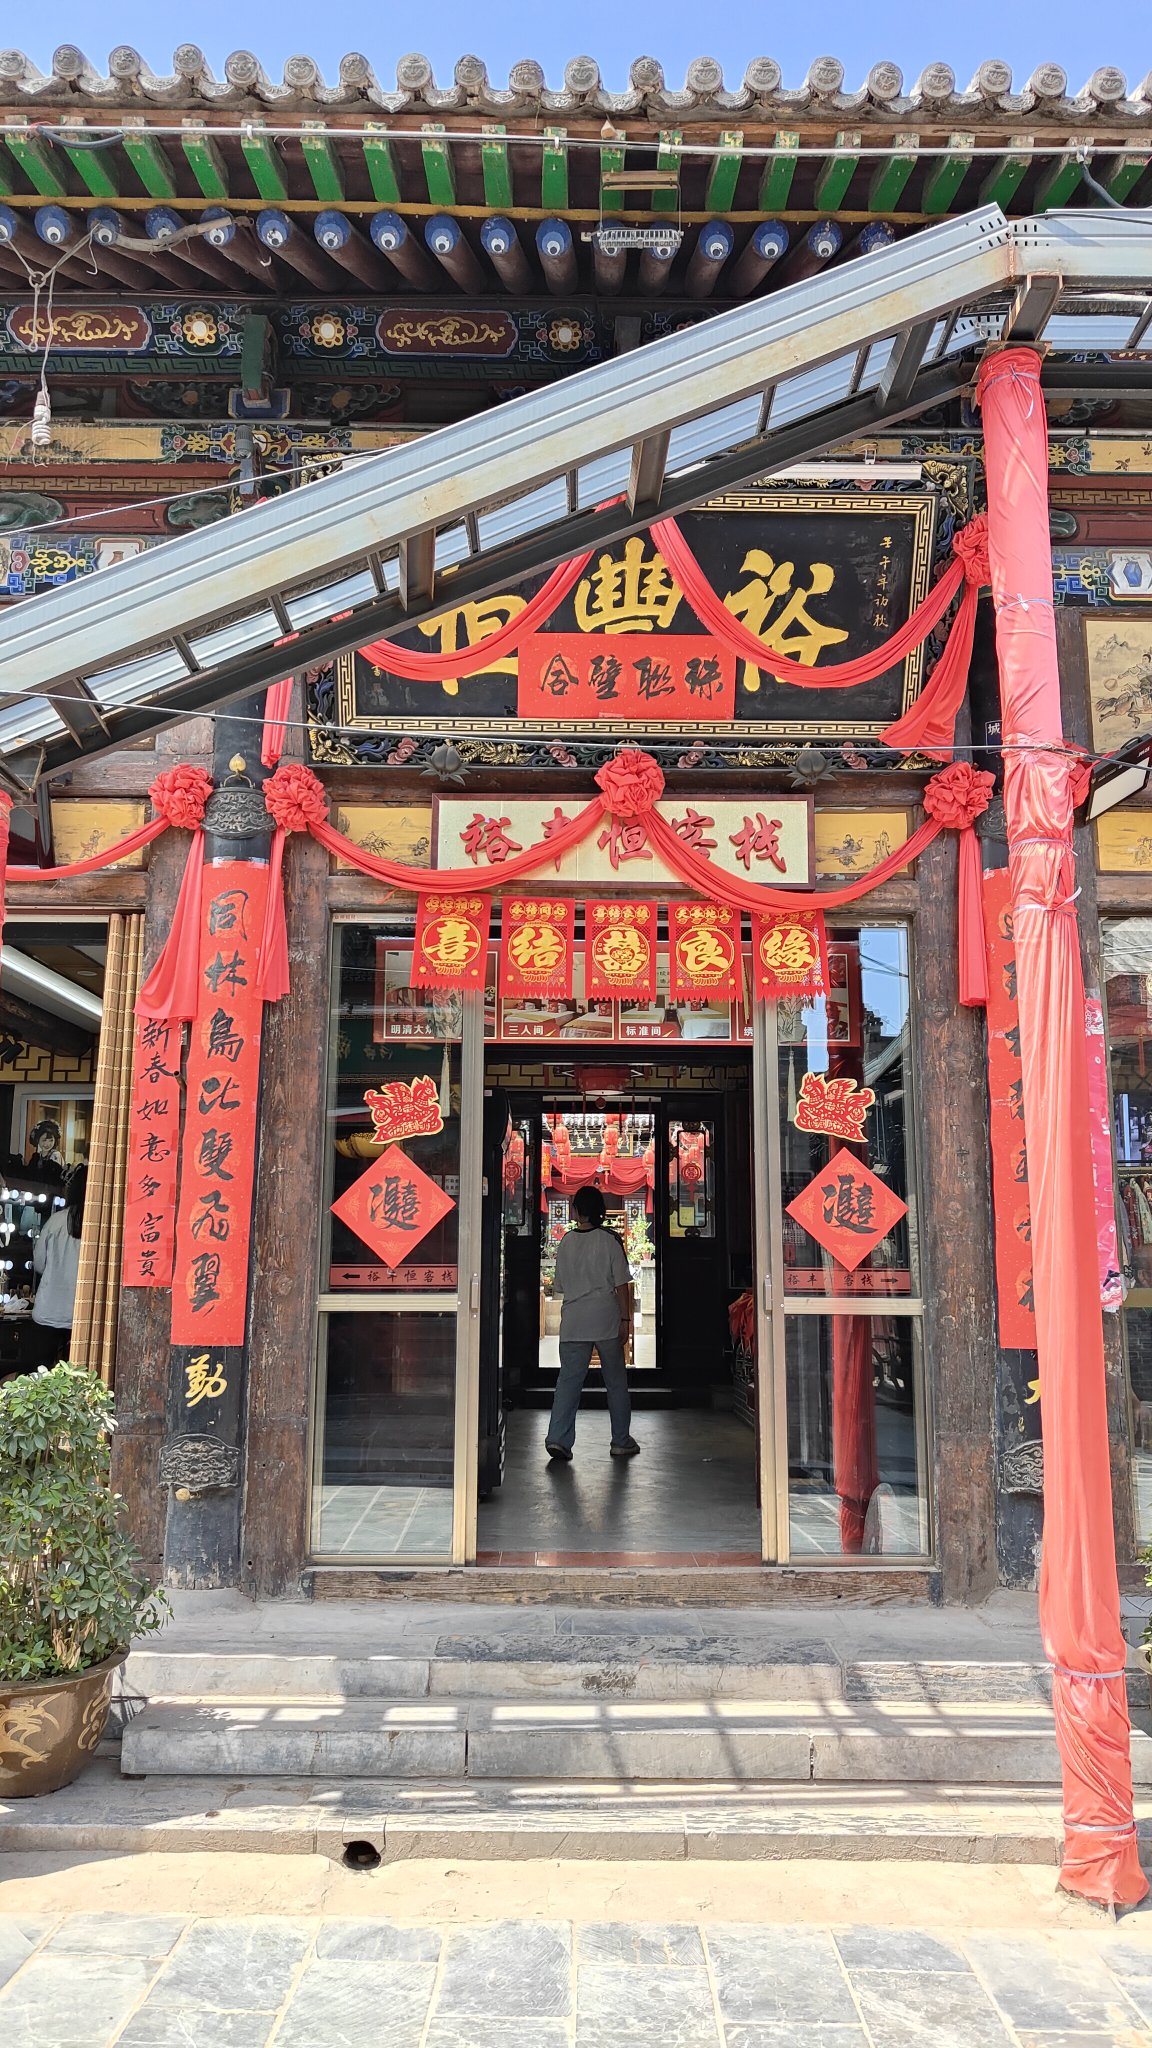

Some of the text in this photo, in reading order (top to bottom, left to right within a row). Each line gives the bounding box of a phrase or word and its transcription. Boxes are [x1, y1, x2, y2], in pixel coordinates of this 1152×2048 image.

[425, 921, 479, 961] 喜
[680, 930, 730, 972] 良
[508, 1025, 544, 1036] 三人间
[625, 1026, 661, 1037] 标准间
[787, 1272, 874, 1287] 裕丰客栈
[184, 1352, 228, 1407] 勤
